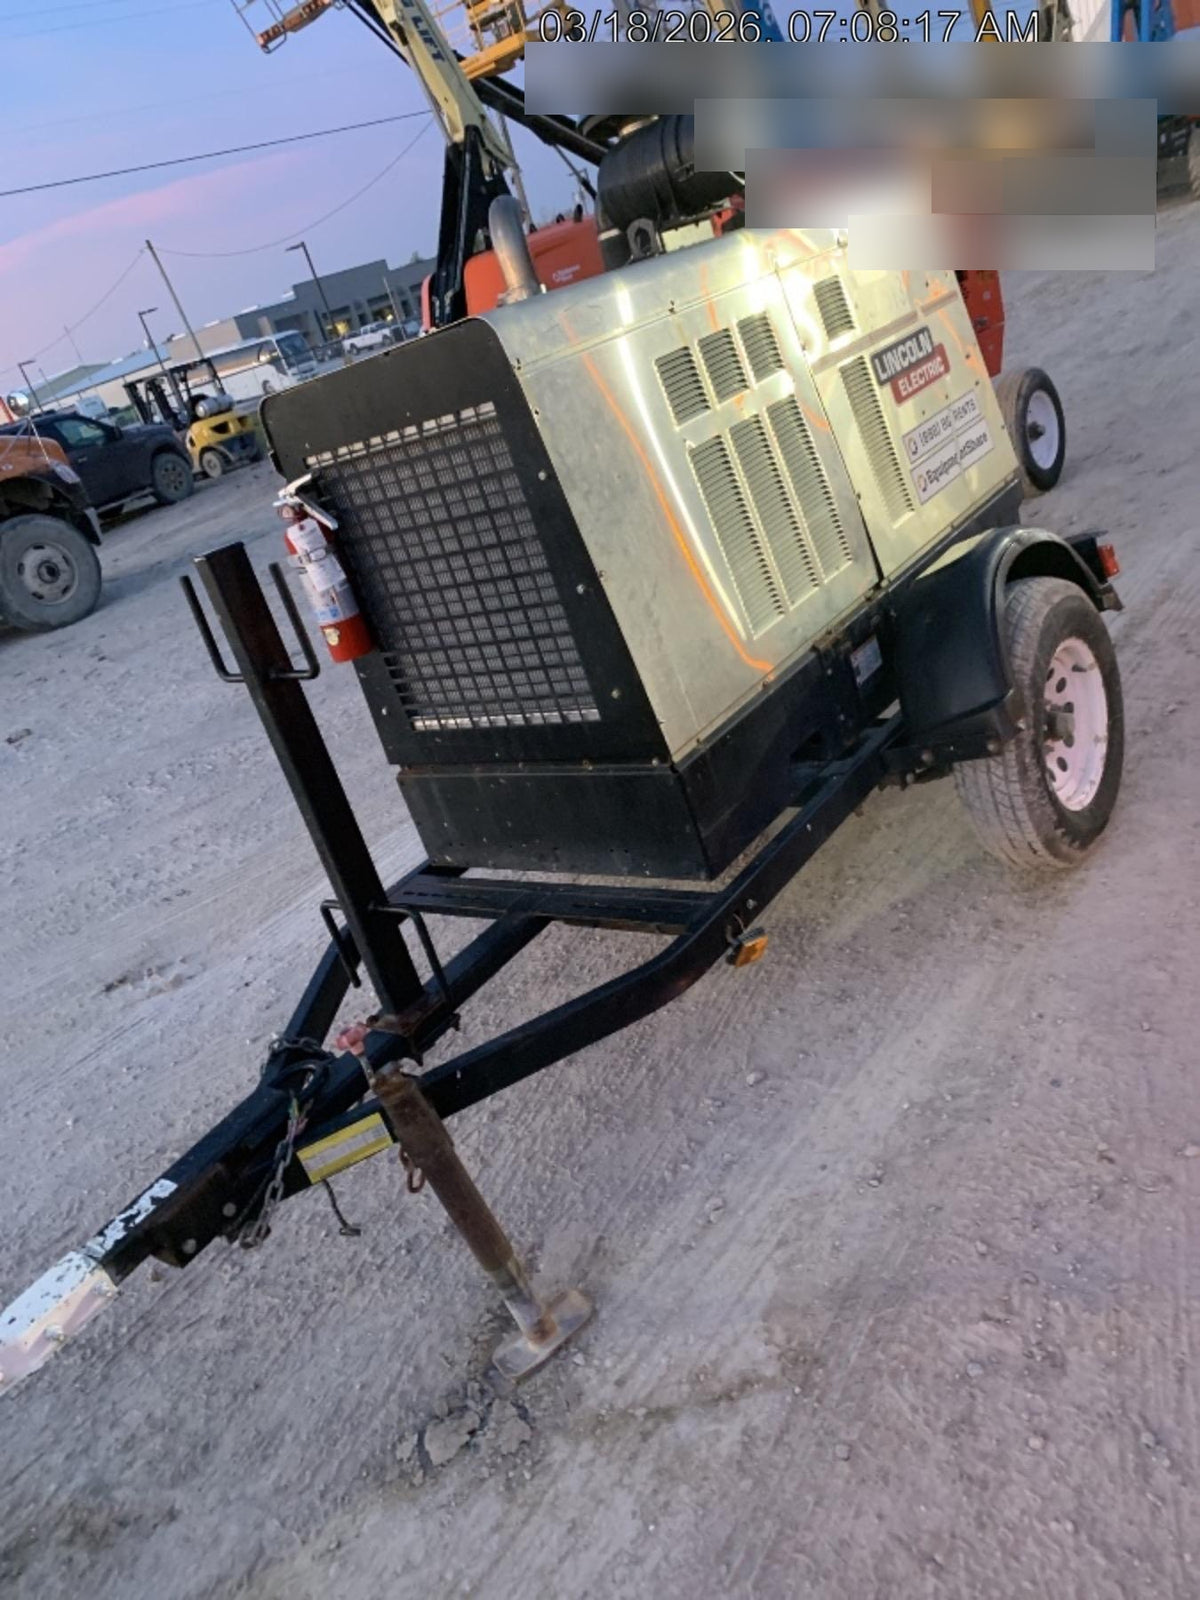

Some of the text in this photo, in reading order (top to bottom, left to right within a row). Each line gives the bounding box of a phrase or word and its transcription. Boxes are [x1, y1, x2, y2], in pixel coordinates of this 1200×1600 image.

[411, 15, 446, 62] LIFT
[874, 331, 932, 381] LINCOLN
[898, 356, 946, 398] ELECTRIC
